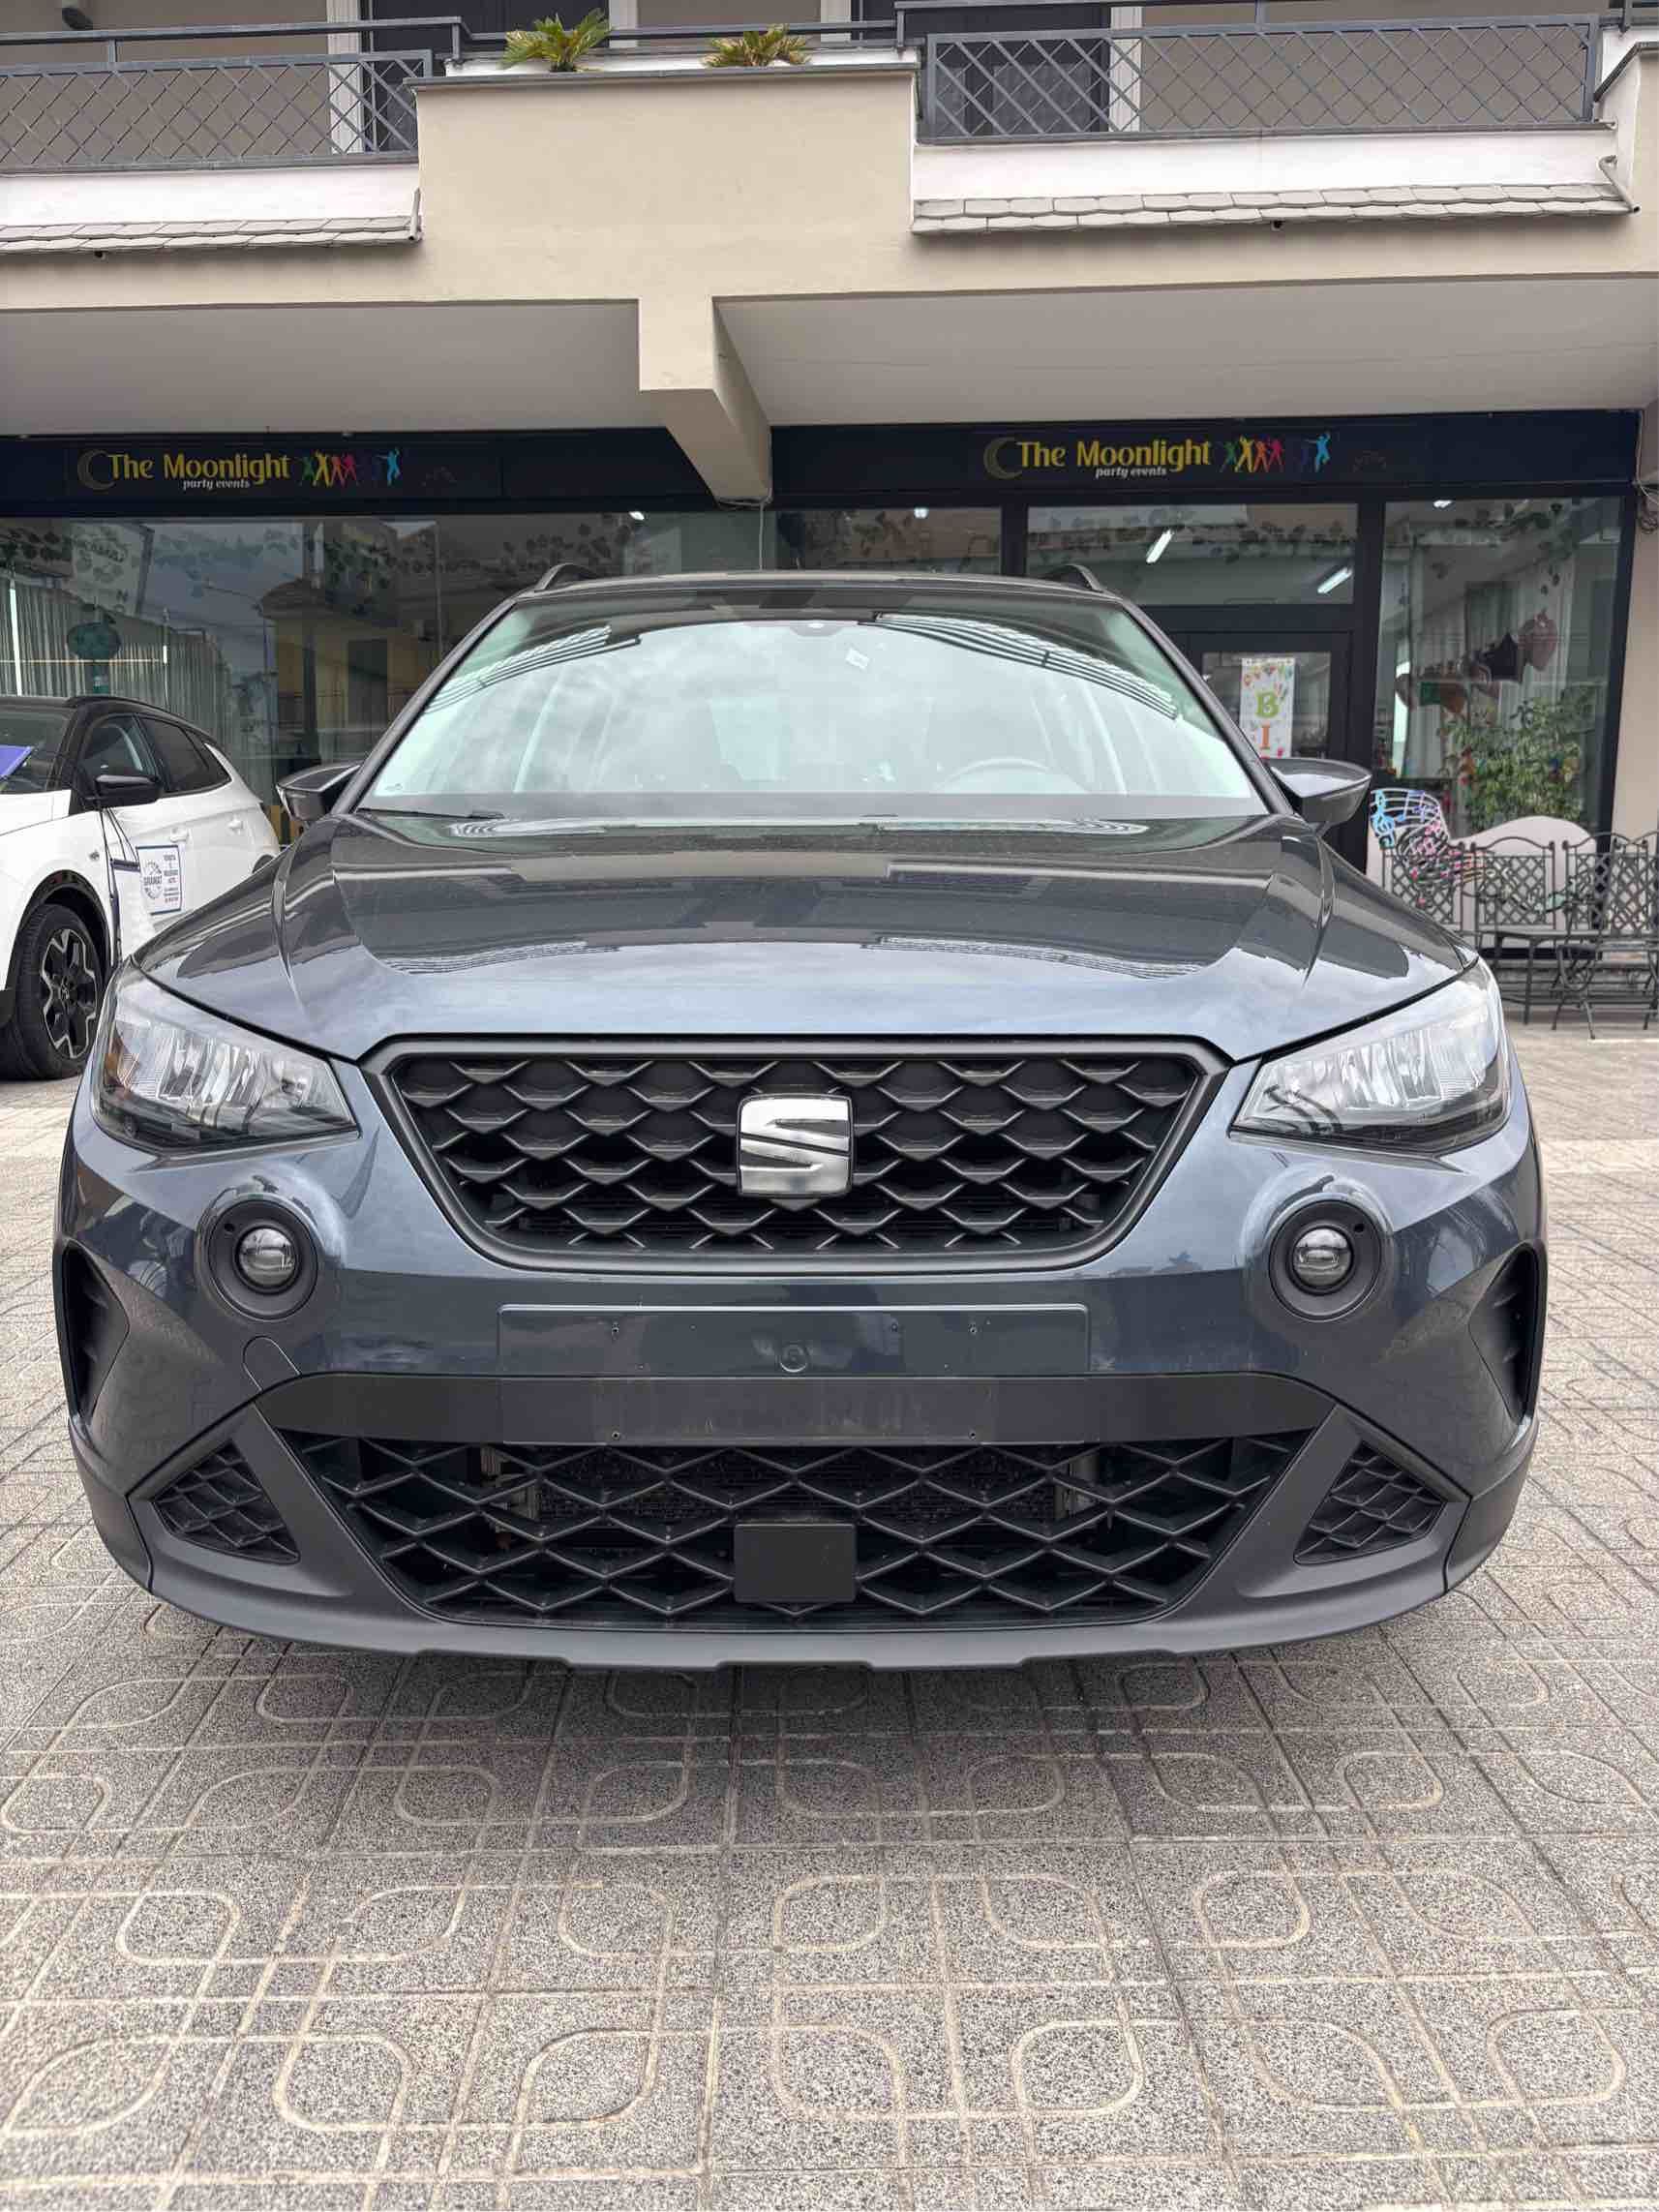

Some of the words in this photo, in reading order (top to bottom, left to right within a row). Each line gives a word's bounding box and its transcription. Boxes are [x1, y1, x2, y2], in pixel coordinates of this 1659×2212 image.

[107, 454, 155, 479] The
[164, 452, 290, 484] Moonlight
[1017, 441, 1065, 468] The
[1077, 439, 1211, 472] Moonlight
[182, 479, 214, 491] party
[215, 478, 251, 489] events
[1095, 467, 1129, 479] party
[1130, 467, 1167, 477] events
[1254, 691, 1280, 759] BI
